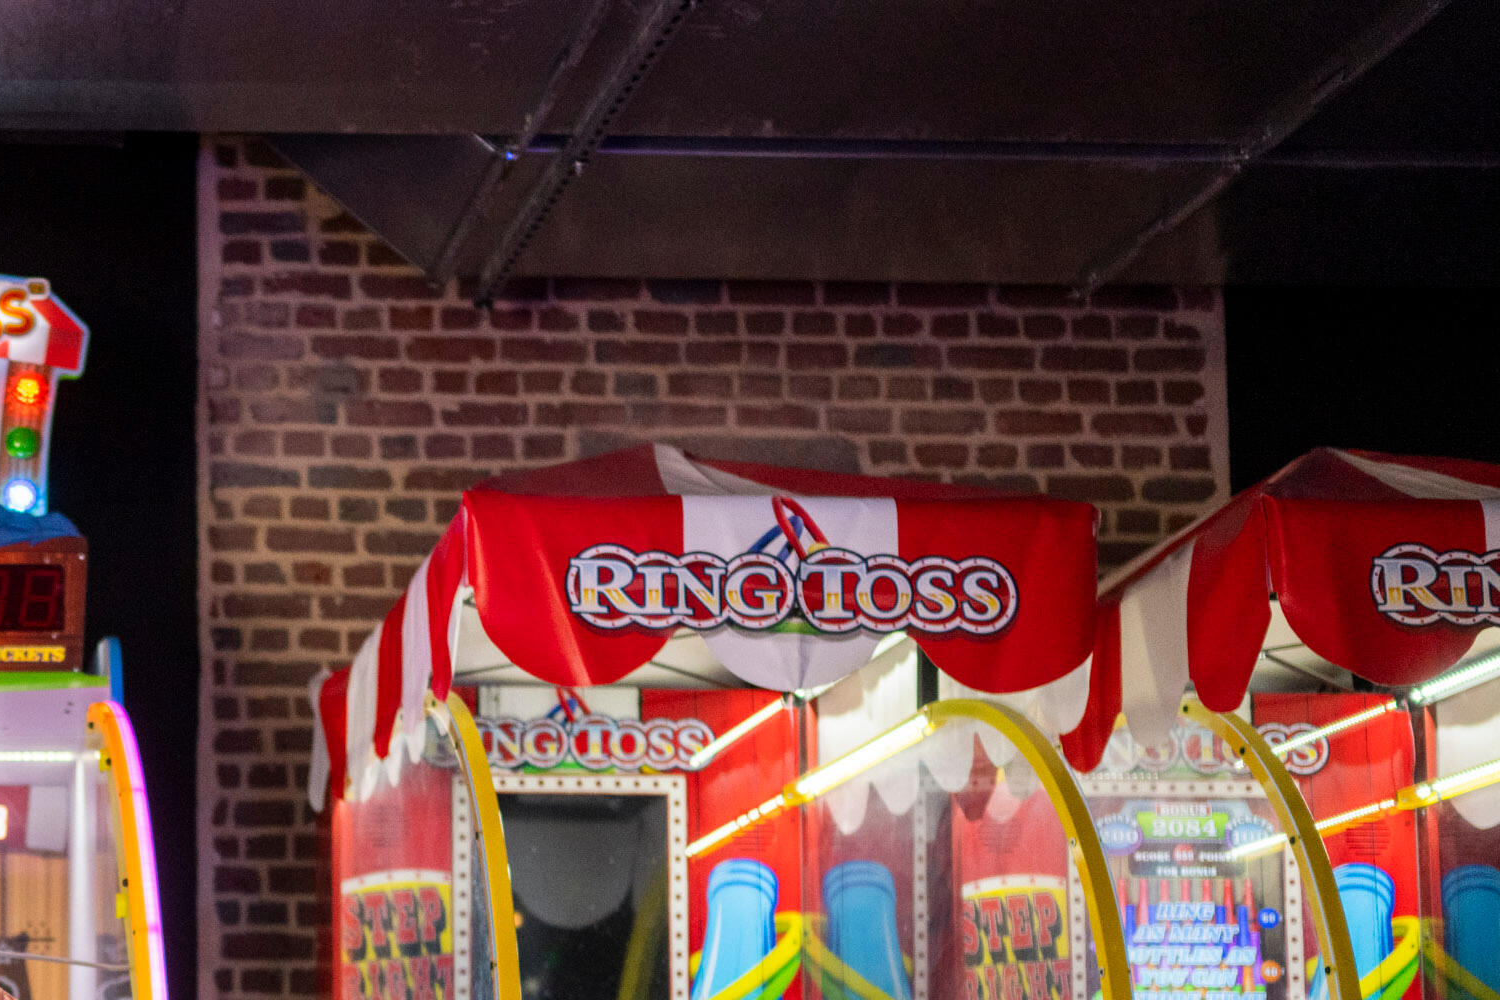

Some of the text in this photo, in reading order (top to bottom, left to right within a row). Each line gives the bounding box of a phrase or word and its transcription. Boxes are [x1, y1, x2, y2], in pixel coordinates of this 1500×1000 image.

[569, 556, 1003, 623] RING TOSS
[341, 887, 444, 956] STEP
[963, 892, 1060, 958] STEP
[1156, 901, 1215, 921] RING
[1128, 946, 1224, 965] OTTLES
